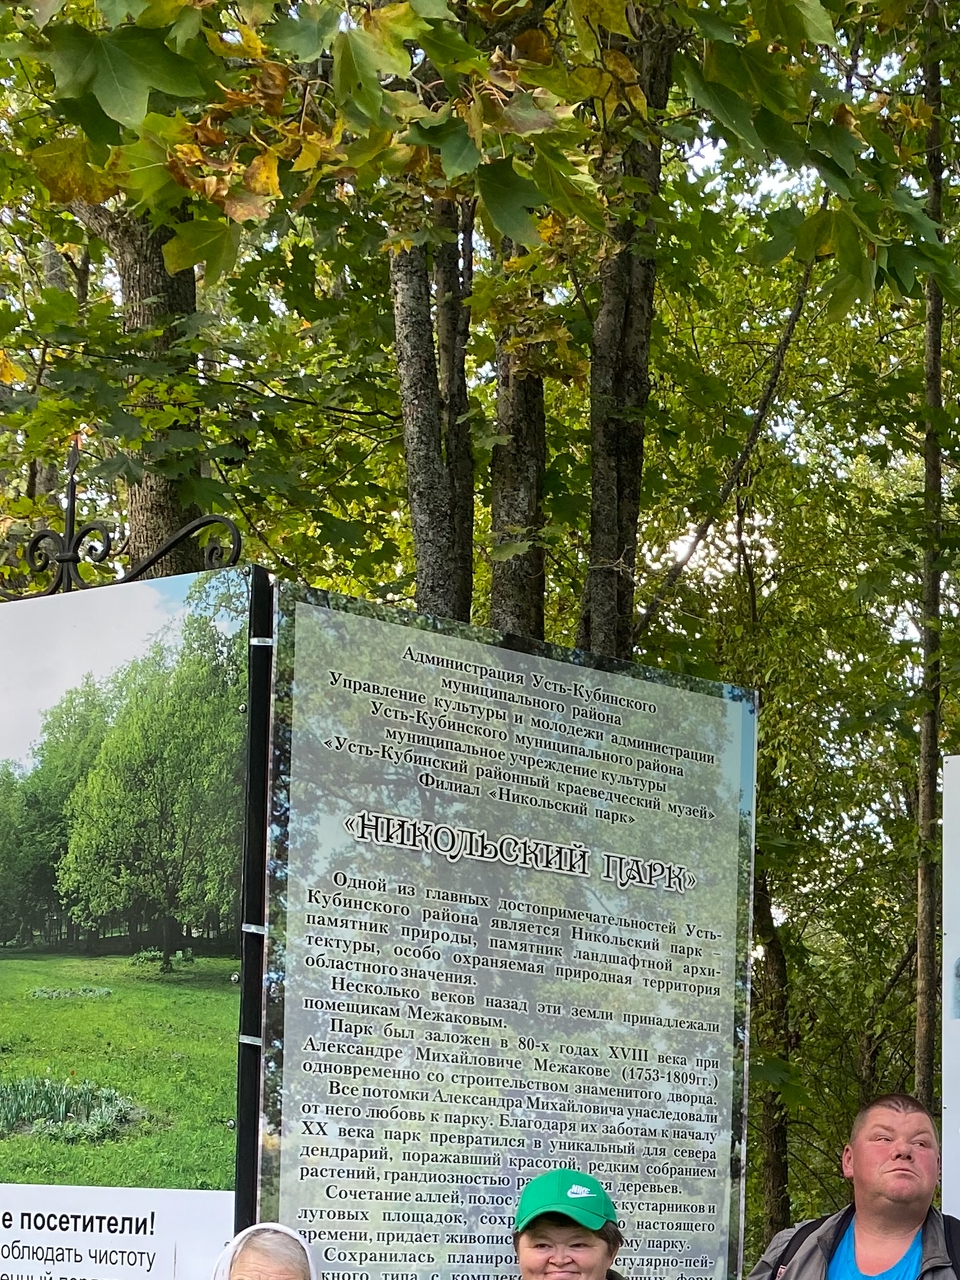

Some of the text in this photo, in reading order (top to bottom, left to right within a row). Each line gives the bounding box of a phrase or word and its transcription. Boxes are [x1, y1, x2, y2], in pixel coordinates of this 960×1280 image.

[401, 646, 657, 714] Администрация Усть-Кубинского
[441, 677, 622, 726] муниципального района
[328, 670, 715, 765] Управление культуры молодежи администрации
[370, 700, 684, 778] Усть-Кубинского муниципального района
[323, 735, 716, 820] «Усть-Кубинский районный краеведческий музей»
[385, 728, 667, 794] муниципальное учреждение культуры
[418, 772, 636, 825] Филиал «Никольский парк»
[344, 808, 696, 897] «НИКОЛЬСКИЙ ПАРК»
[307, 888, 703, 960] Кубинского района является Никольский парк
[333, 871, 722, 941] Одной из главных достопримечательностей Усть-
[304, 952, 477, 986] областного значения.
[305, 934, 721, 998] тектуры, особо охраняемая природная территория
[306, 913, 722, 979] памятник природы, памятник ландшафтной архи-
[302, 1036, 719, 1090] Александре Михайловиче Межакове (1753-1809гг.)
[302, 1061, 718, 1107] одновременно со строительством знаменитого дворца.
[571, 1184, 591, 1195] NIKE
[0, 1238, 157, 1274] облюдать чистоту
[19, 1211, 156, 1237] посетители!
